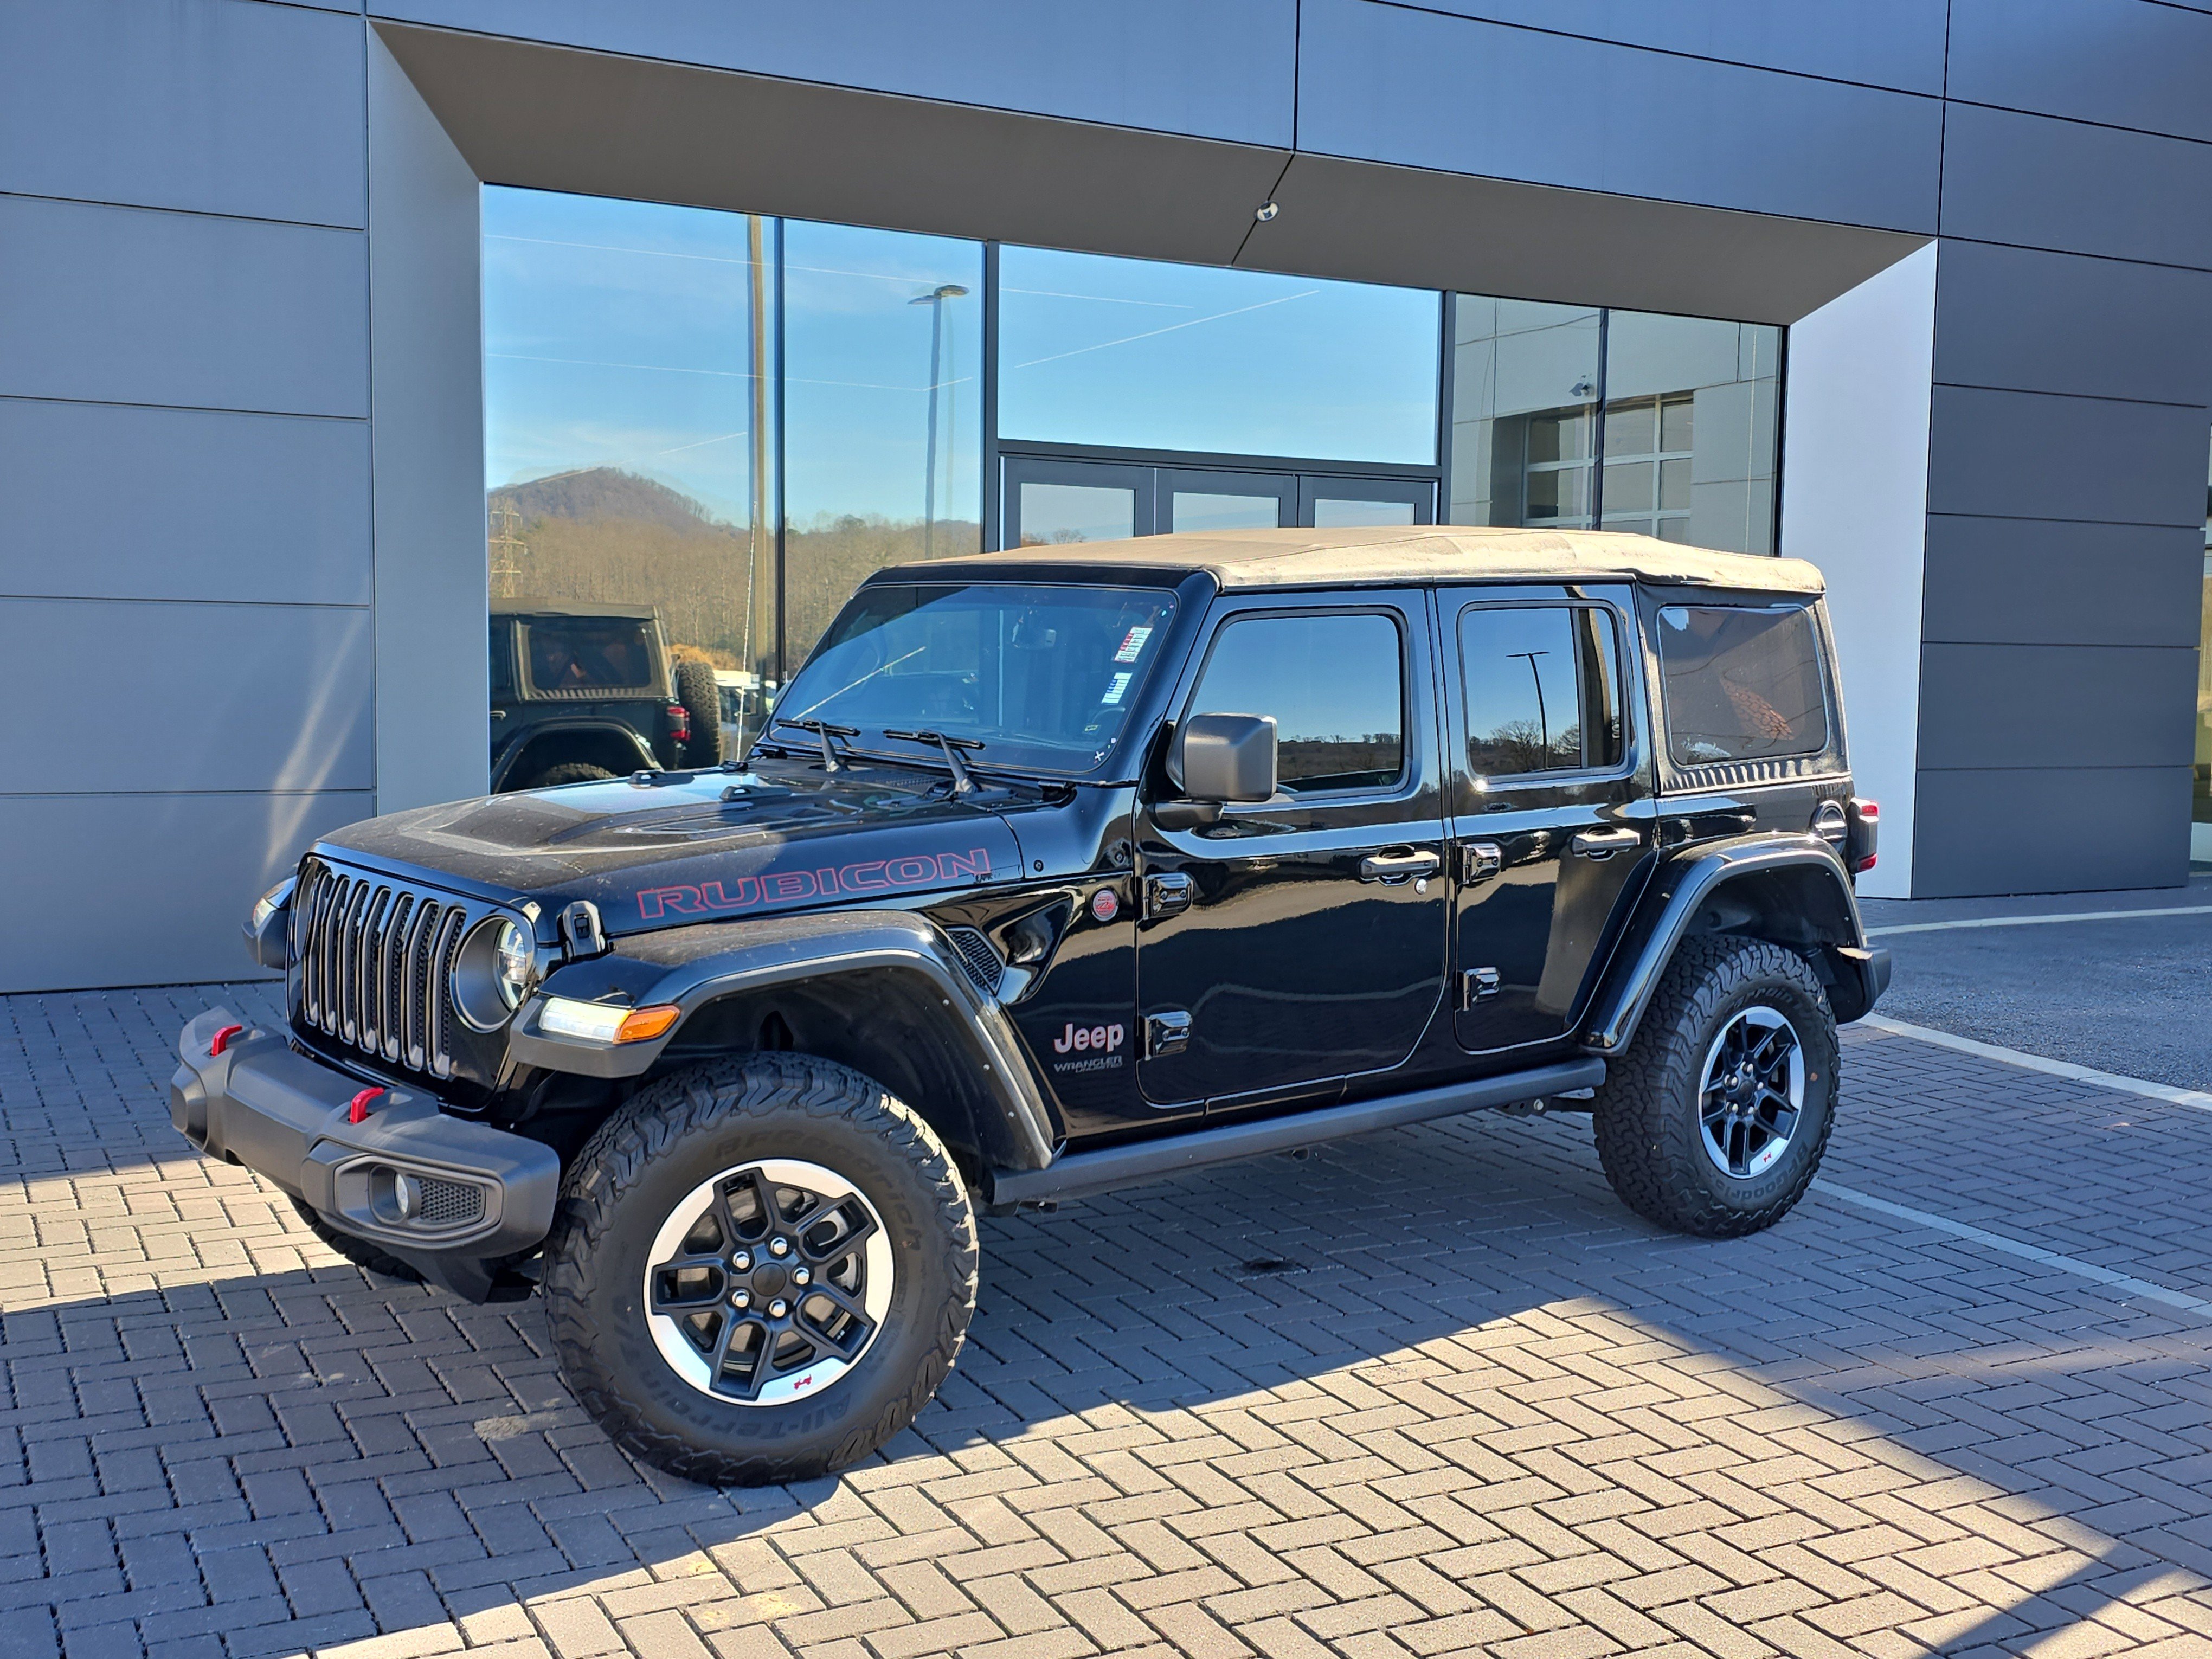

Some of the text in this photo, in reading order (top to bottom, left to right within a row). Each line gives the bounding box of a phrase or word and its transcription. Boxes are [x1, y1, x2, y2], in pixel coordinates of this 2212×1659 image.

[636, 848, 991, 919] RUBICON
[1053, 1023, 1124, 1053] Jeep
[1053, 1055, 1122, 1073] WRANGLER
